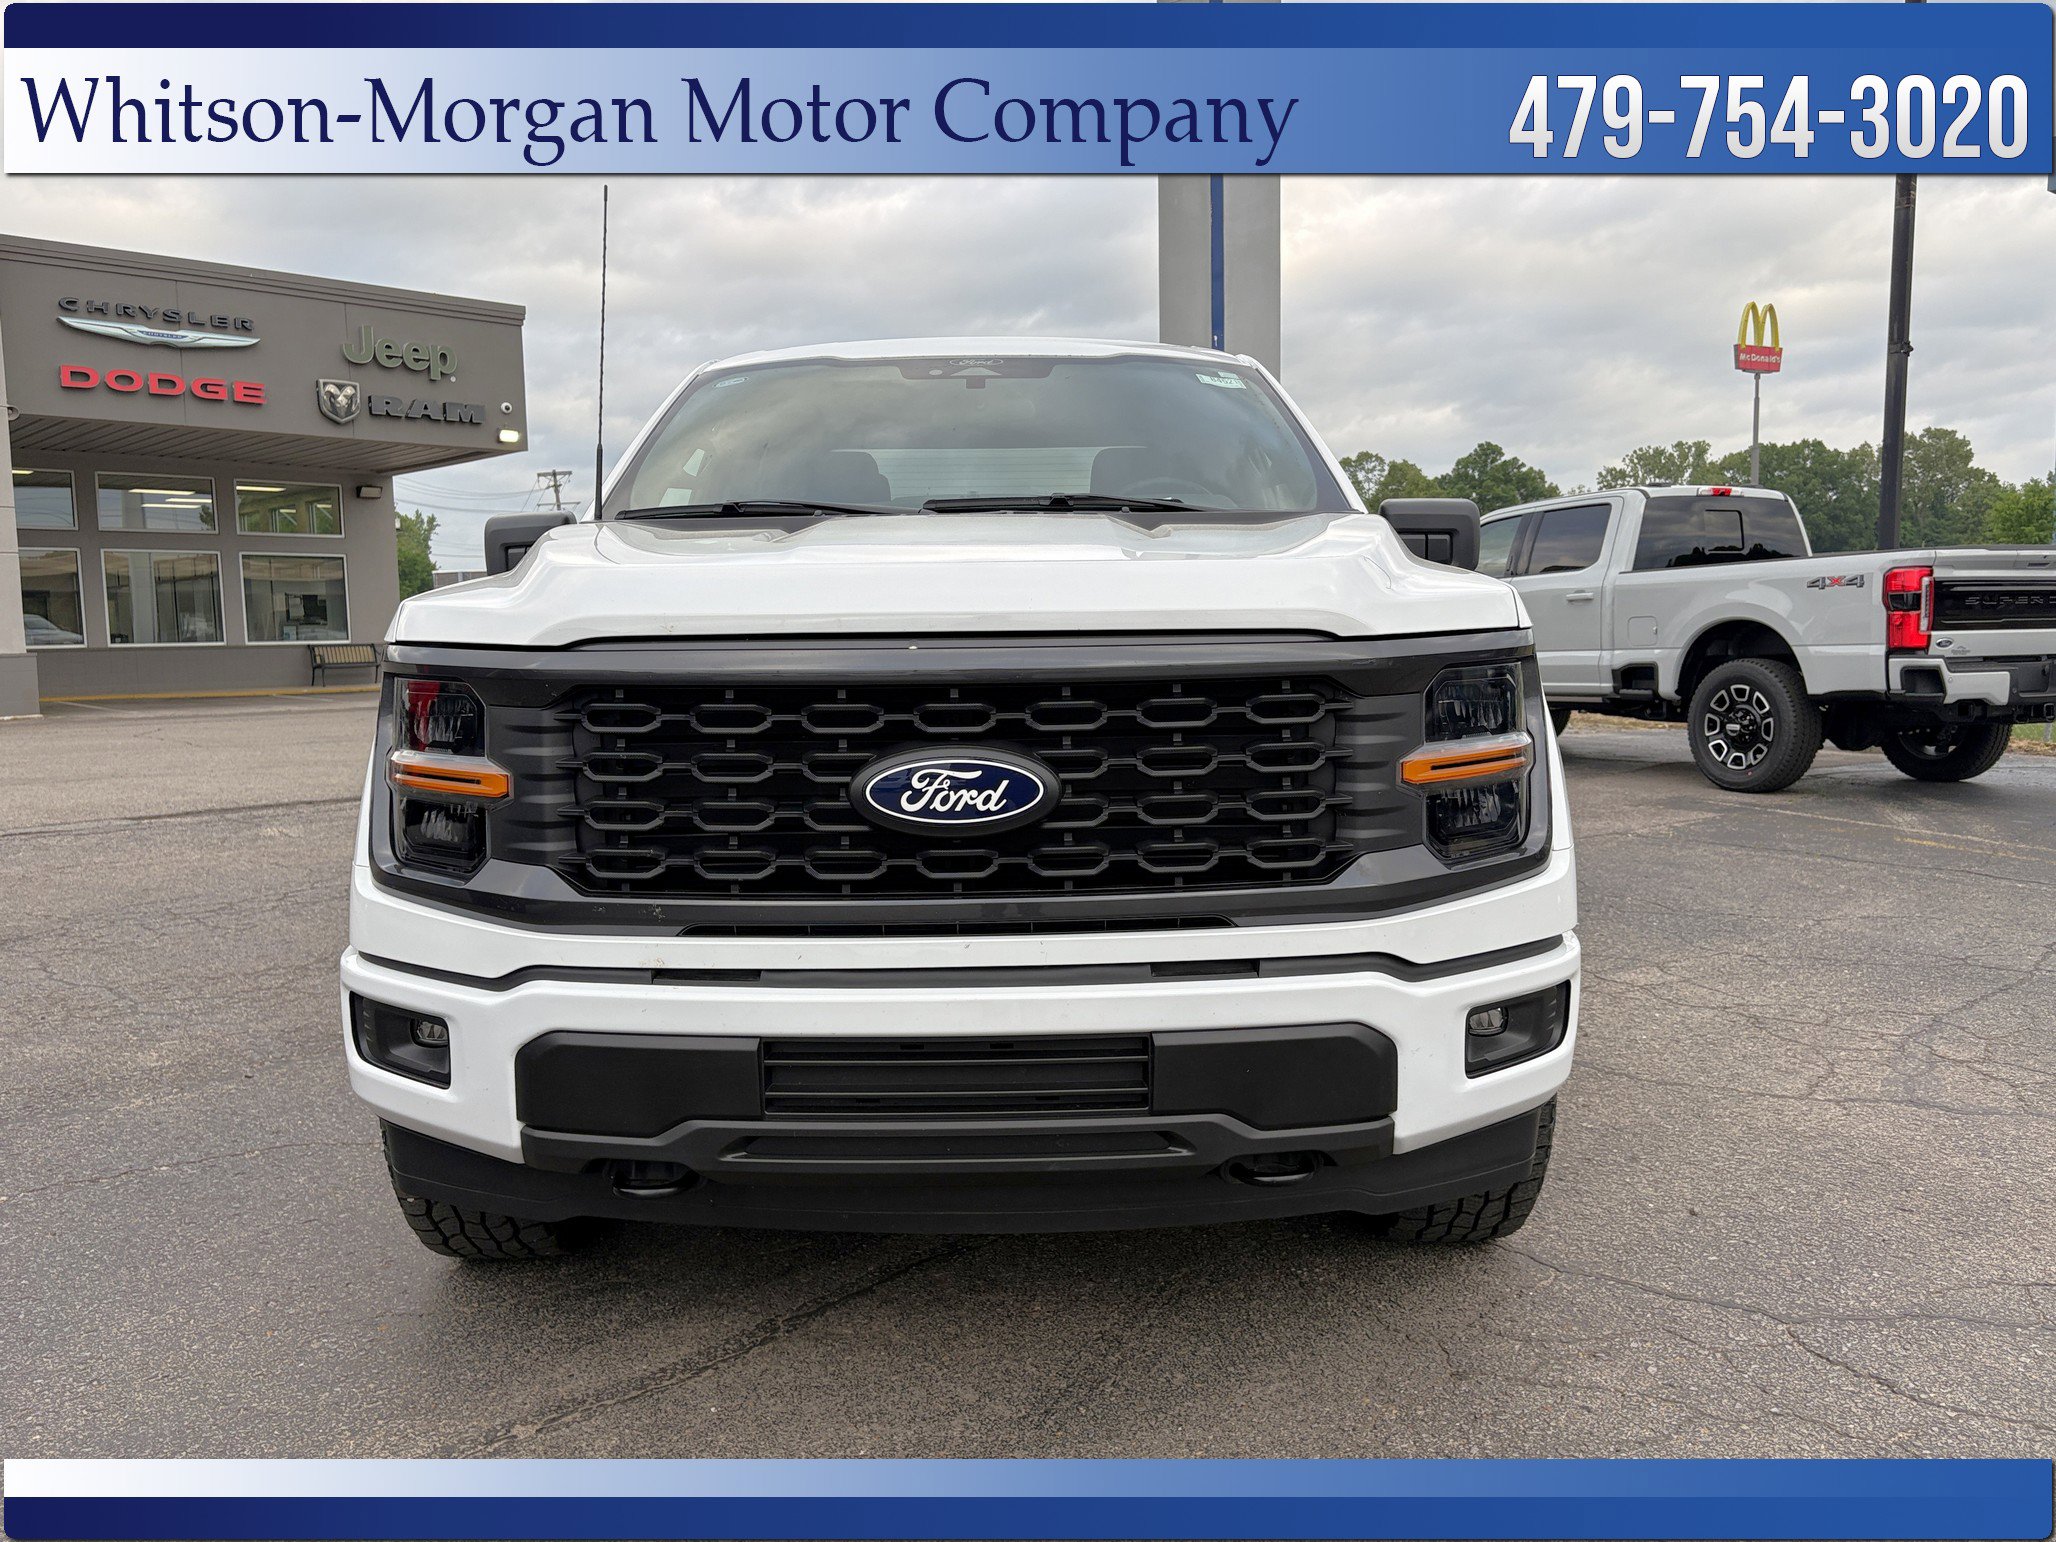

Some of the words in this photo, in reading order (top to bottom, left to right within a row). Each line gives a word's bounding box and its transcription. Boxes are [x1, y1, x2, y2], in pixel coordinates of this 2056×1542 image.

[58, 297, 254, 331] CHRYSLER
[341, 324, 458, 380] Jeep
[1739, 352, 1781, 363] McDonald's
[59, 364, 267, 405] DODGE
[368, 394, 486, 425] RAM
[900, 768, 1010, 812] Ford
